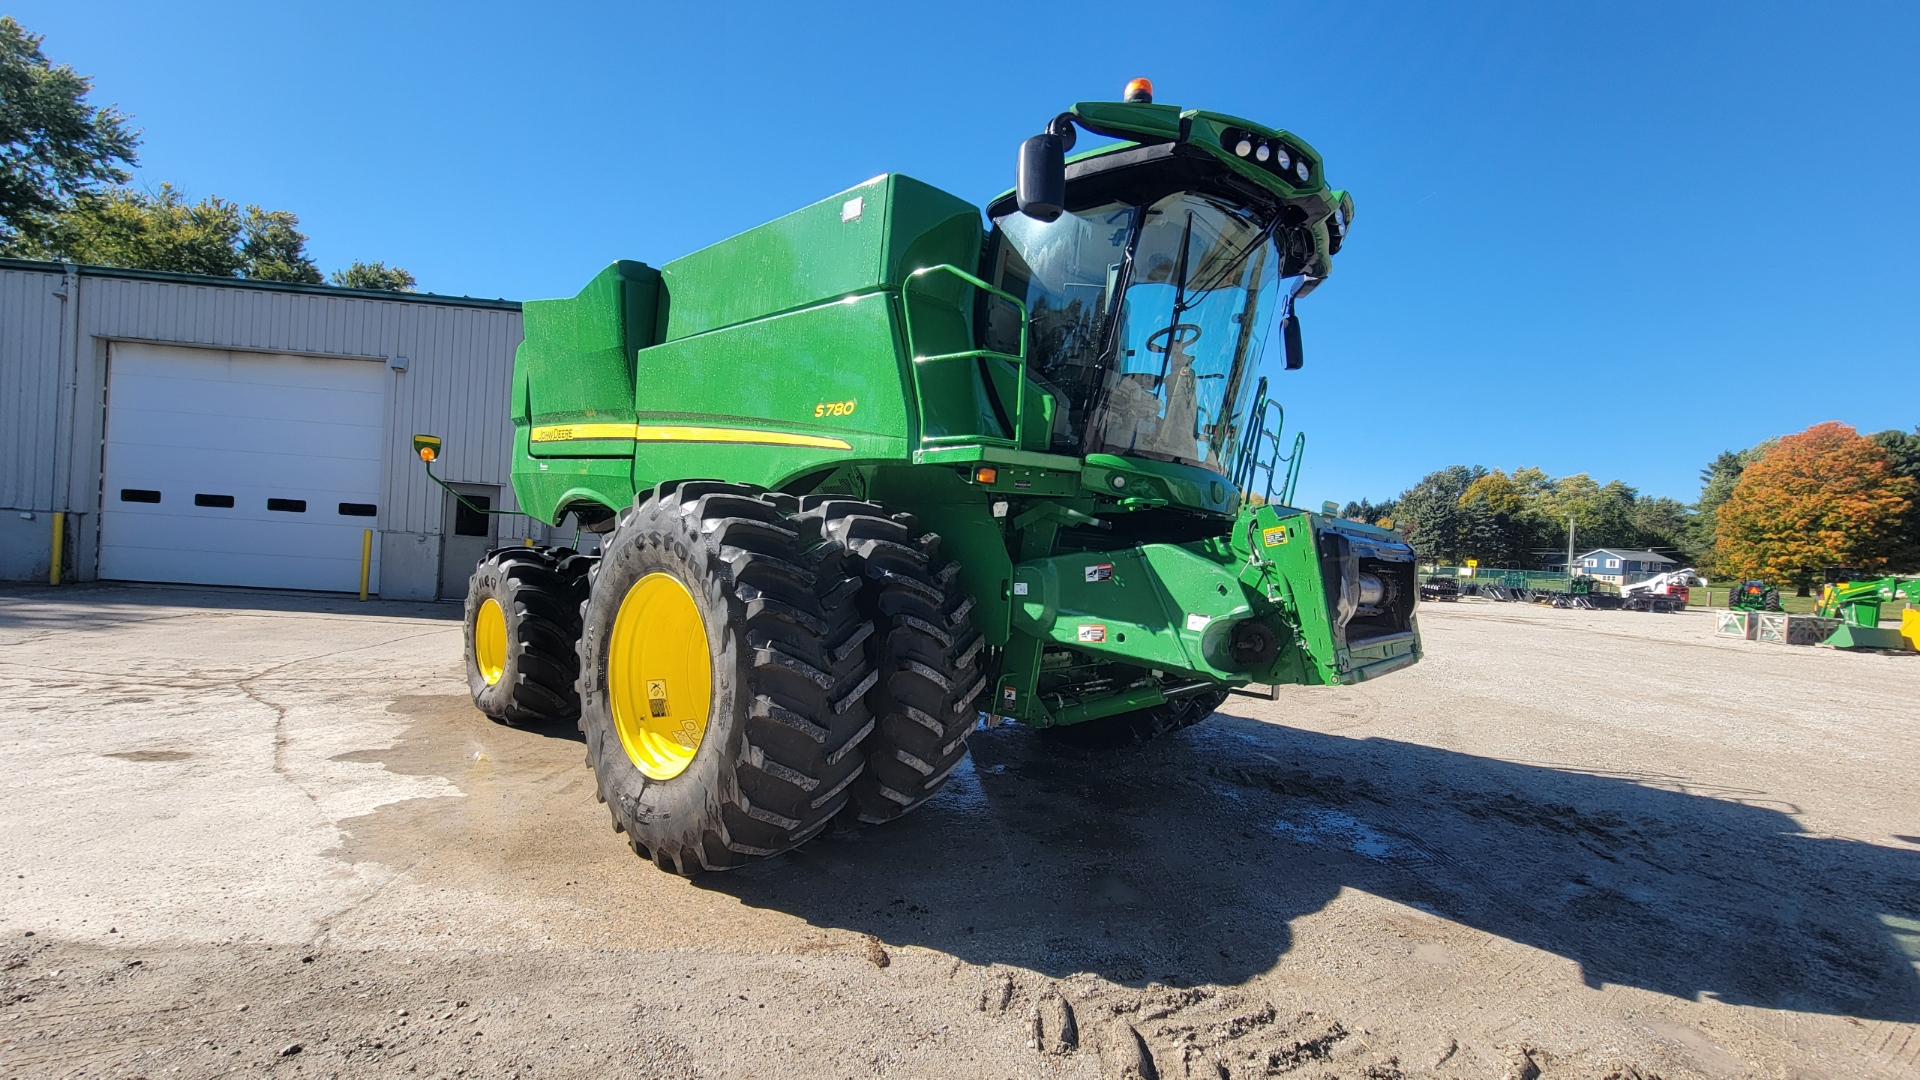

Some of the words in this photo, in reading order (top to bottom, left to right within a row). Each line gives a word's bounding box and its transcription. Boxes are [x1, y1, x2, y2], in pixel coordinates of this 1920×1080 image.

[814, 400, 855, 418] S780
[538, 430, 553, 440] JOHN
[553, 428, 573, 439] DEERE
